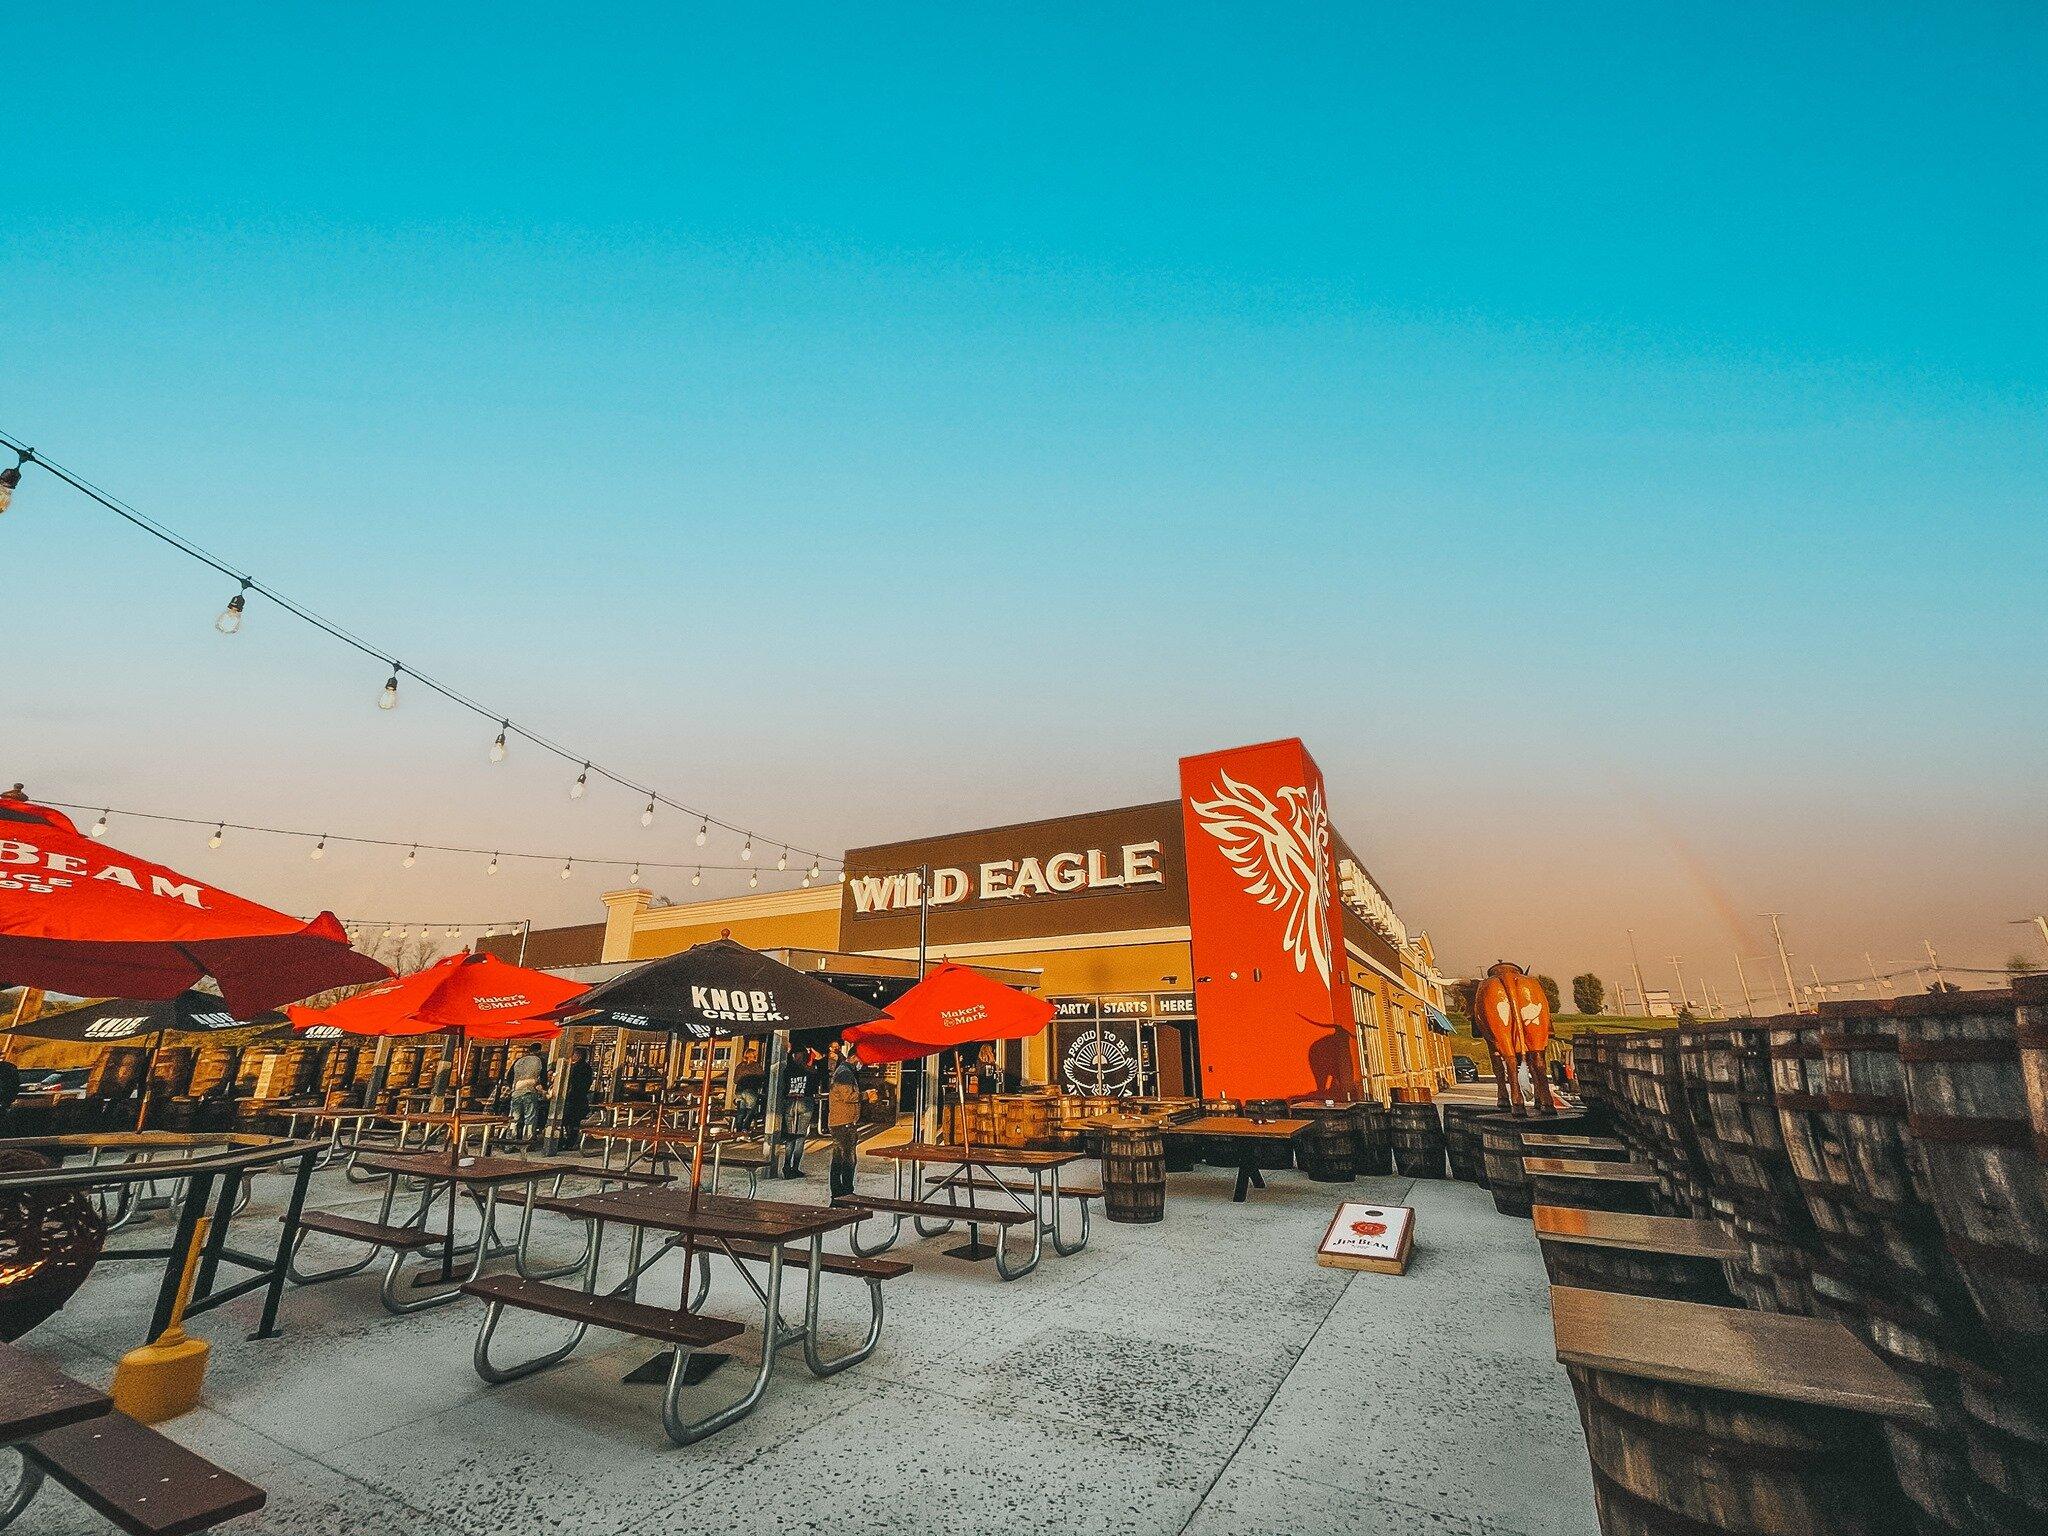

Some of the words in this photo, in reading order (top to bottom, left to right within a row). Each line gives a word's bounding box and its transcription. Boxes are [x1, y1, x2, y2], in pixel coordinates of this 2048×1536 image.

[0, 839, 205, 909] BEAM
[850, 866, 972, 913] WILD
[979, 840, 1163, 900] EAGLE
[473, 993, 525, 1005] Maker's
[492, 999, 531, 1010] Mark
[691, 985, 769, 1012] KNOB
[941, 1004, 985, 1018] Maker's
[1104, 1001, 1148, 1014] STARTS
[1160, 1000, 1194, 1012] HERE
[955, 1011, 988, 1025] Mark
[1068, 1030, 1096, 1057] PROUD
[1104, 1031, 1116, 1041] TO
[1117, 1039, 1129, 1055] BE
[1332, 1238, 1355, 1246] JIM
[1359, 1238, 1389, 1250] BEAM
